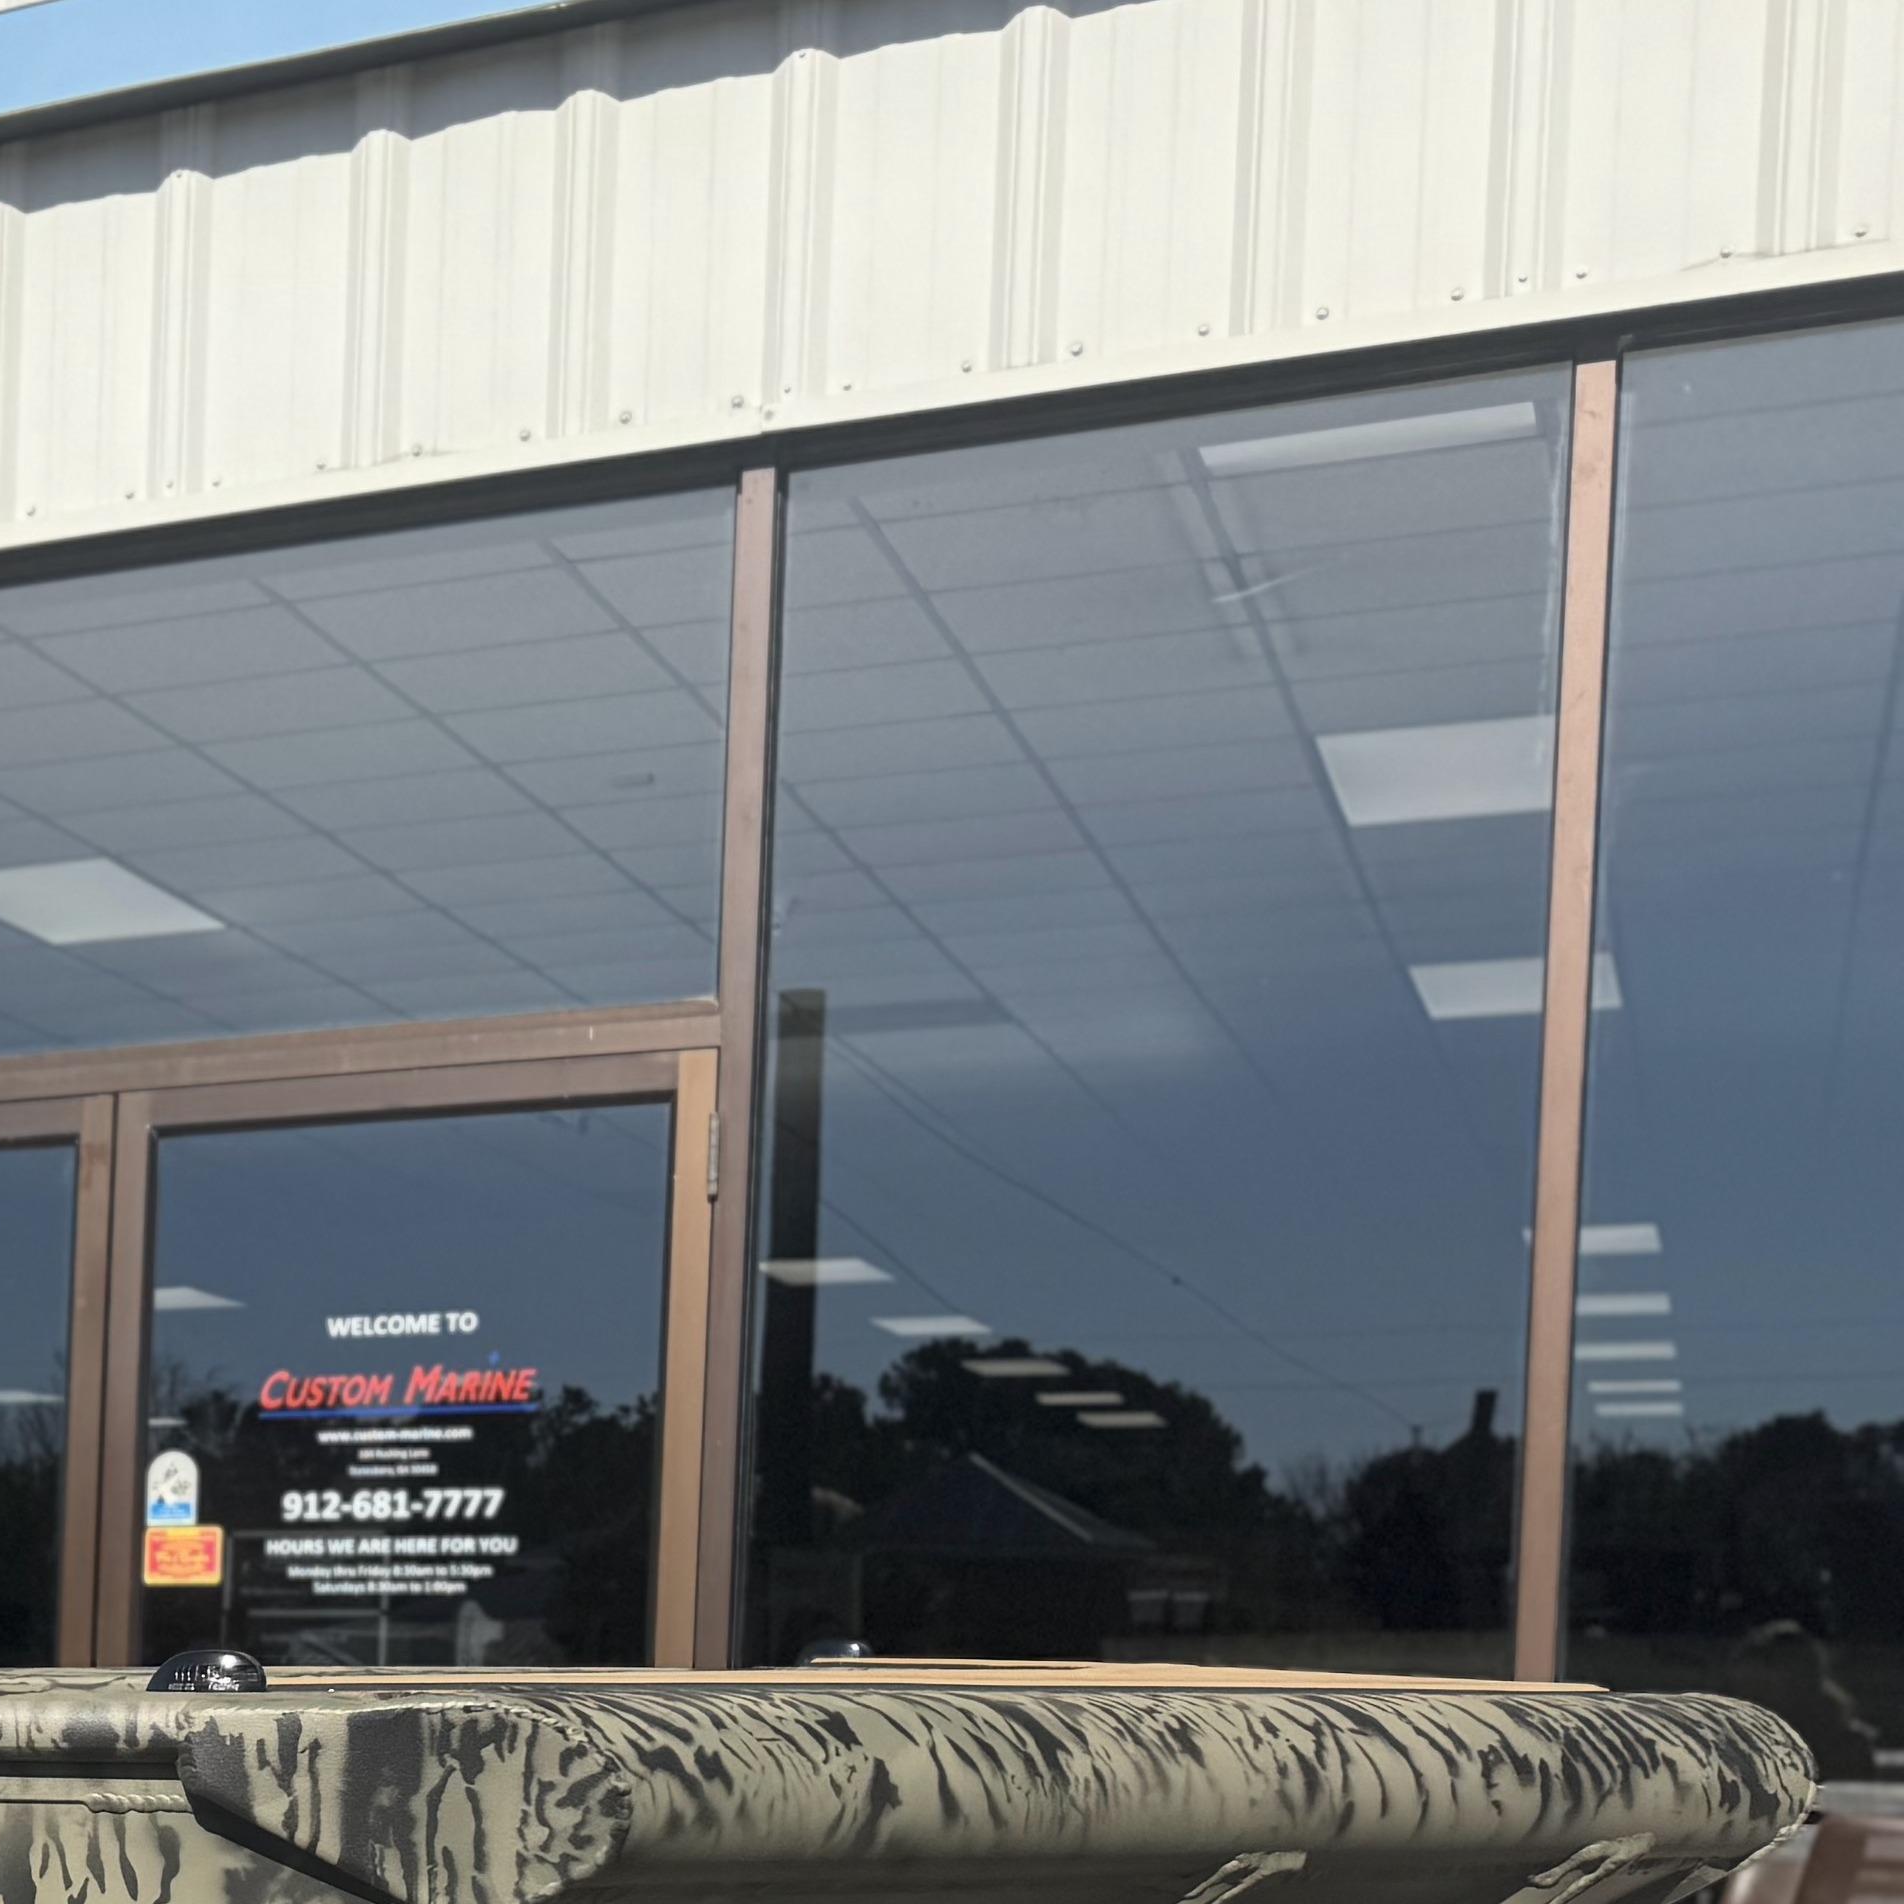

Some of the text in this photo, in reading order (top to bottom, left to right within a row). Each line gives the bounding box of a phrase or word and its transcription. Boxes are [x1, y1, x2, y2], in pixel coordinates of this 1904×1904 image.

[327, 1312, 478, 1338] WELCOME TO
[260, 1365, 538, 1409] CUSTOM MARINE
[317, 1428, 473, 1443] www.custom-marine.com
[282, 1487, 504, 1520] 912-681-7777
[265, 1537, 519, 1556] HOURS WE ARE HERE FOR YOU
[288, 1566, 331, 1579] Monday
[358, 1565, 391, 1578] Friday
